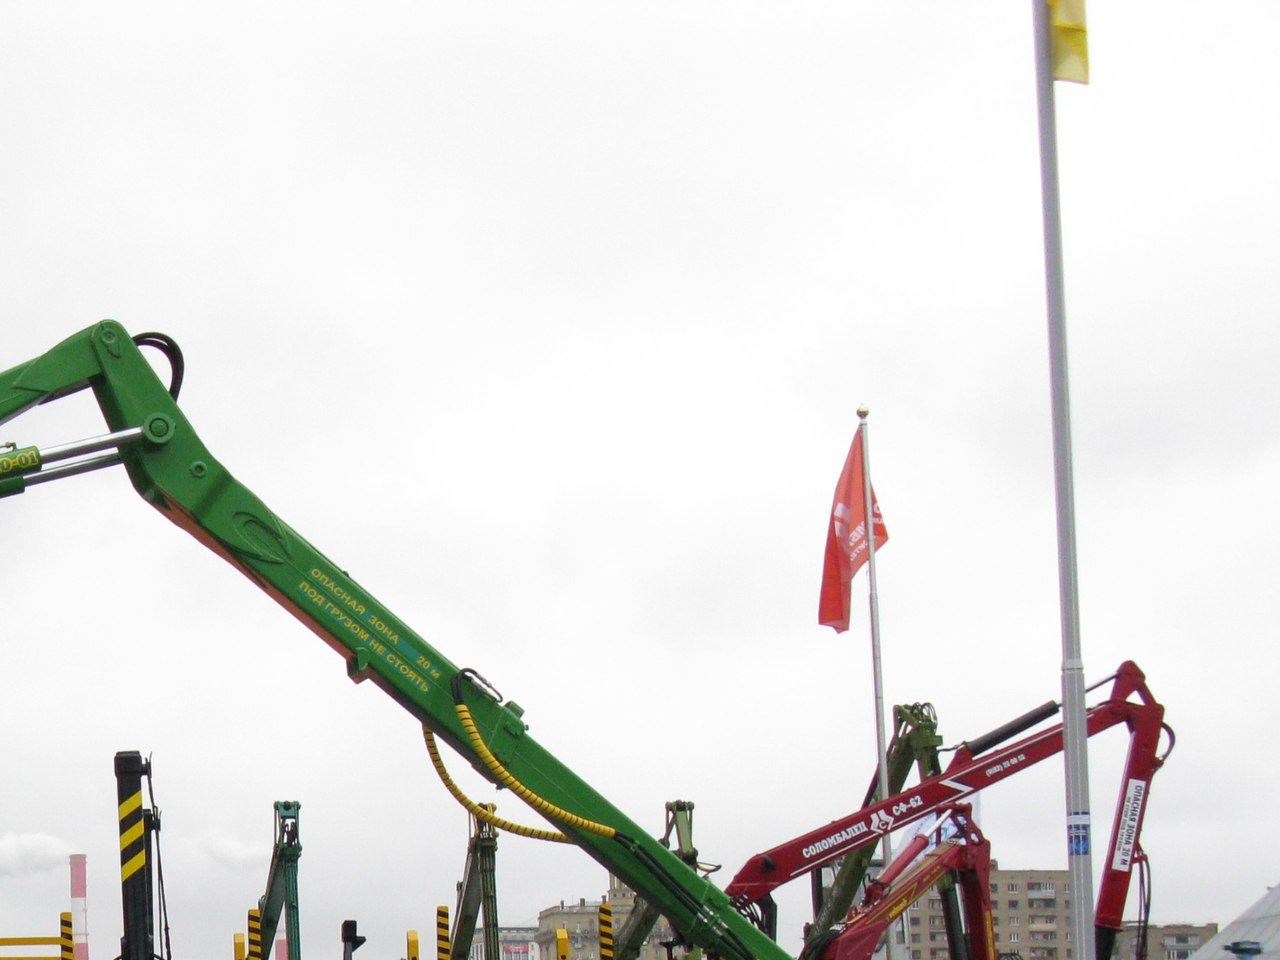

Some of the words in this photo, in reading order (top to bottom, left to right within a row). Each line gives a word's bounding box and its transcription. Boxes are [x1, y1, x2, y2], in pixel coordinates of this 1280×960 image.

[299, 581, 326, 605] ПОД
[325, 602, 370, 641] ГРУЗОМ
[369, 640, 387, 655] НЕ
[387, 654, 429, 692] СТОЯТЬ
[311, 568, 366, 615] ОПАСНАЯ
[368, 615, 400, 644] ЗОНА
[416, 656, 430, 669] 20
[802, 821, 868, 858] СОЛОМБАЛЕЦ
[892, 796, 924, 816] СФ-62
[1129, 785, 1143, 822] ОПАСНАЯ
